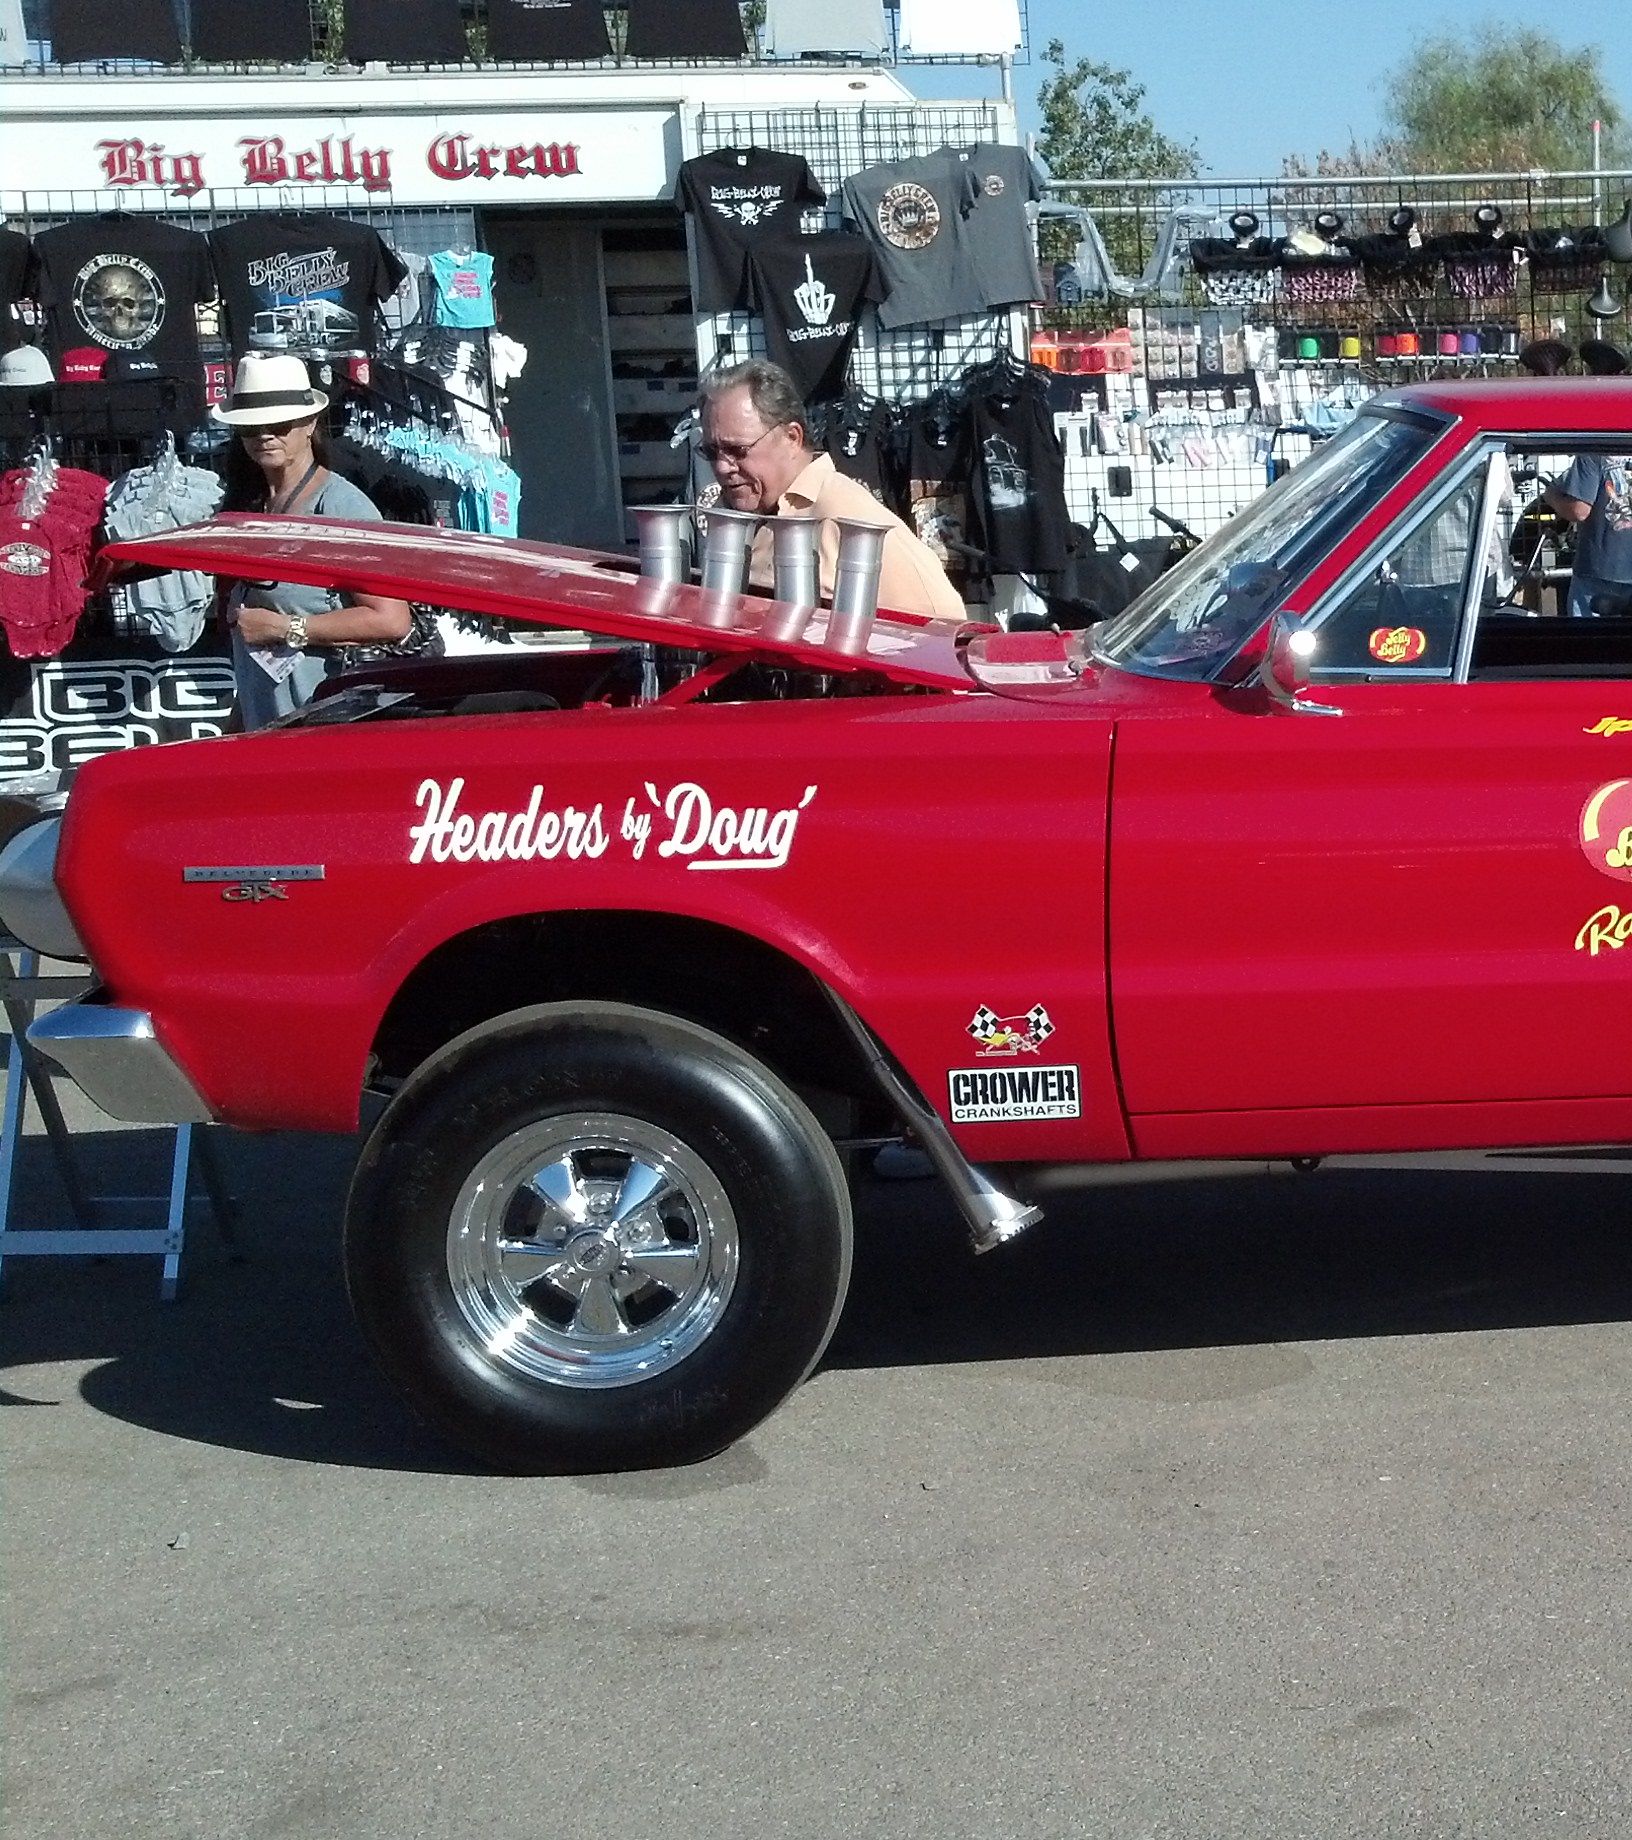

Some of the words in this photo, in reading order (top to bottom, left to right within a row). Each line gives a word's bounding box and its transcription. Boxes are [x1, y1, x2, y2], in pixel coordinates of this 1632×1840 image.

[95, 137, 206, 197] Big
[234, 132, 393, 192] Belly
[426, 130, 583, 180] Crew
[247, 252, 290, 286] BIG
[266, 247, 338, 295] BELLY
[285, 261, 350, 298] CREW
[1376, 642, 1407, 662] Belly
[31, 657, 238, 723] BIG
[408, 777, 610, 864] Headers
[620, 797, 652, 861] by
[952, 1069, 1077, 1106] CROWER
[954, 1103, 1078, 1120] CRANKSHAFTS
